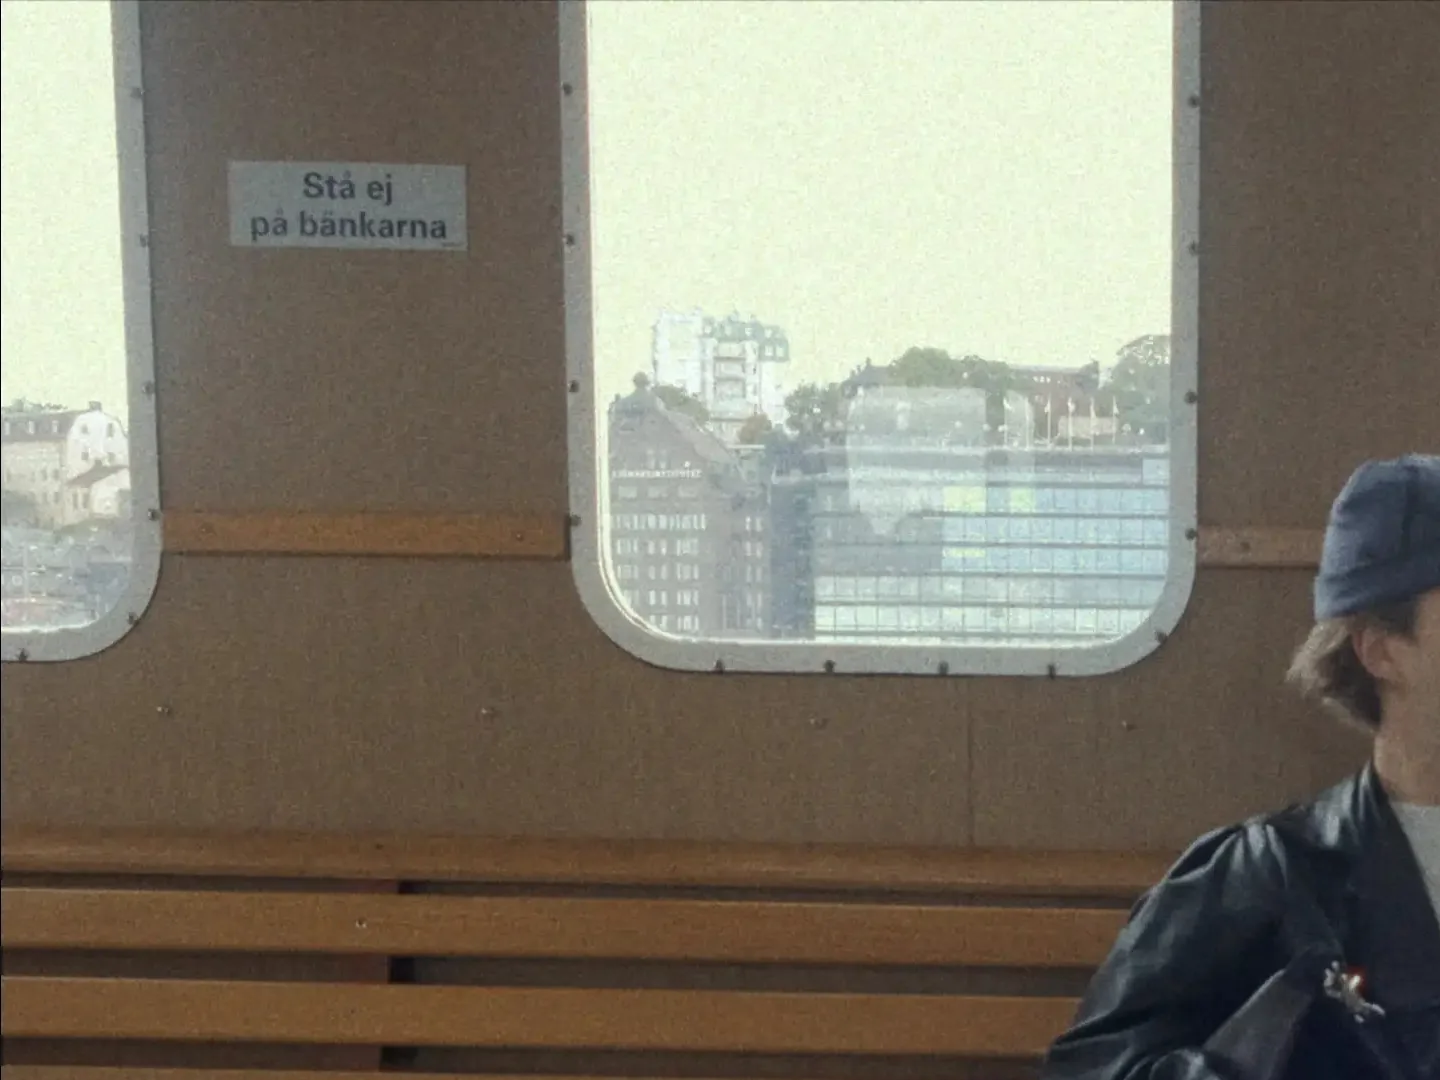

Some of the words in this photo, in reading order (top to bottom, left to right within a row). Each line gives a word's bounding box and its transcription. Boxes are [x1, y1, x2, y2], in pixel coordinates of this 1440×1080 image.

[303, 170, 355, 200] Stå
[366, 173, 393, 205] ej
[251, 207, 288, 241] på
[300, 209, 447, 240] bänkarna
